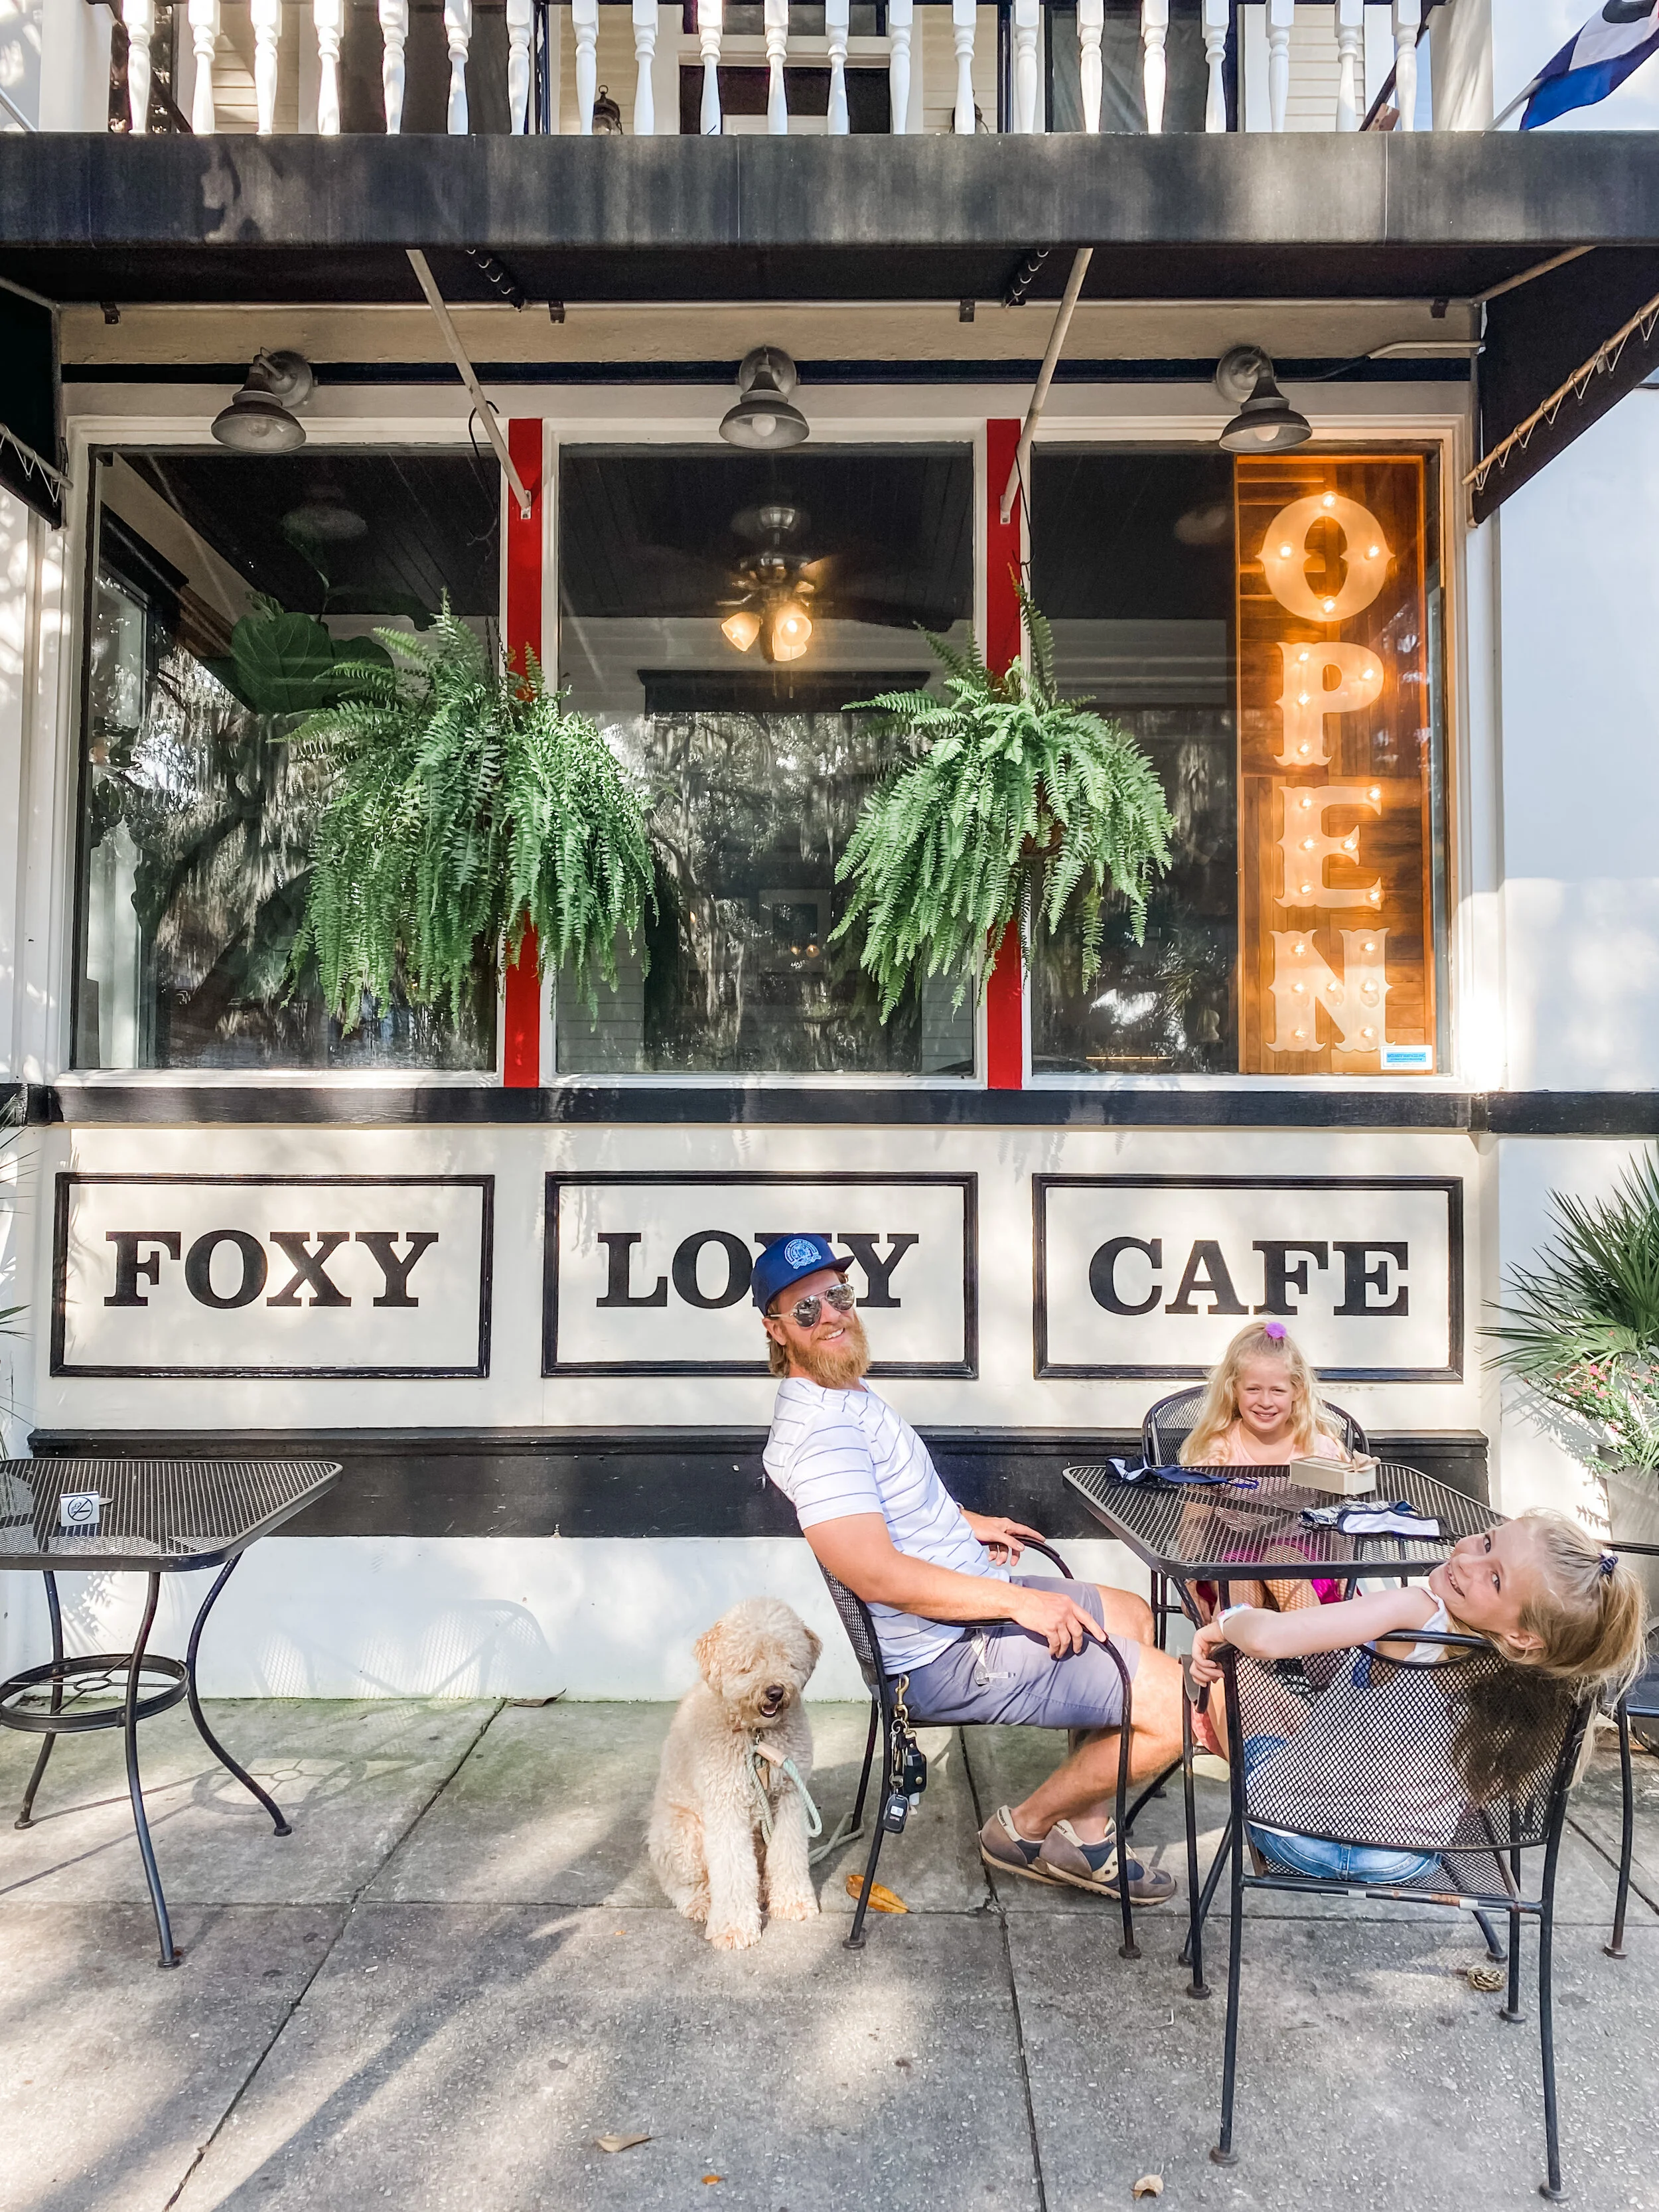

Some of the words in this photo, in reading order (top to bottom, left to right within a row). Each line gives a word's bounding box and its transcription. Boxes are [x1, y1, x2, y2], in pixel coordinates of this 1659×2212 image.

[1254, 491, 1396, 1053] OPEN
[103, 1229, 439, 1309] FOXY
[597, 1229, 919, 1309] LOY
[1088, 1236, 1409, 1317] CAFE
